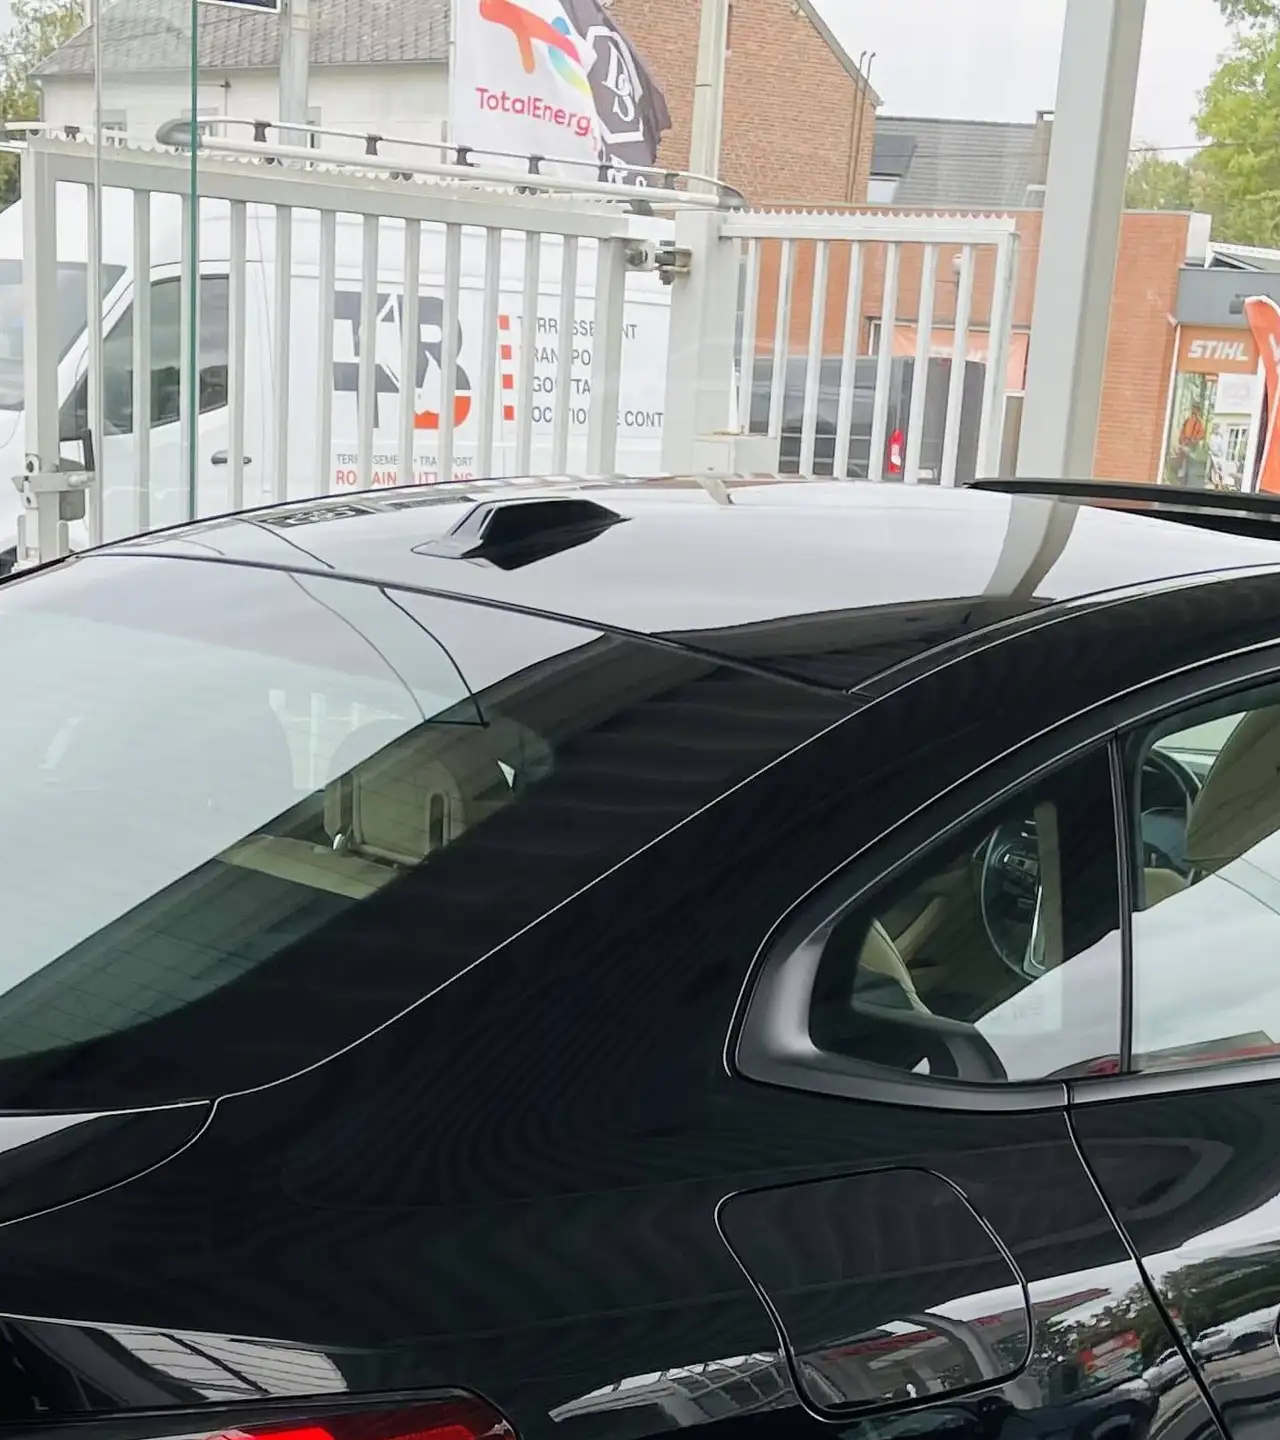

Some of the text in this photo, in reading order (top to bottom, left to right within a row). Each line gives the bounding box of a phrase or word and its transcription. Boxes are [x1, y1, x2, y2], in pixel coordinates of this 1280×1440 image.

[475, 87, 594, 144] TotalEnerg
[1187, 339, 1249, 362] STIHL
[624, 410, 664, 428] CONT
[335, 469, 398, 486] ROAIN
